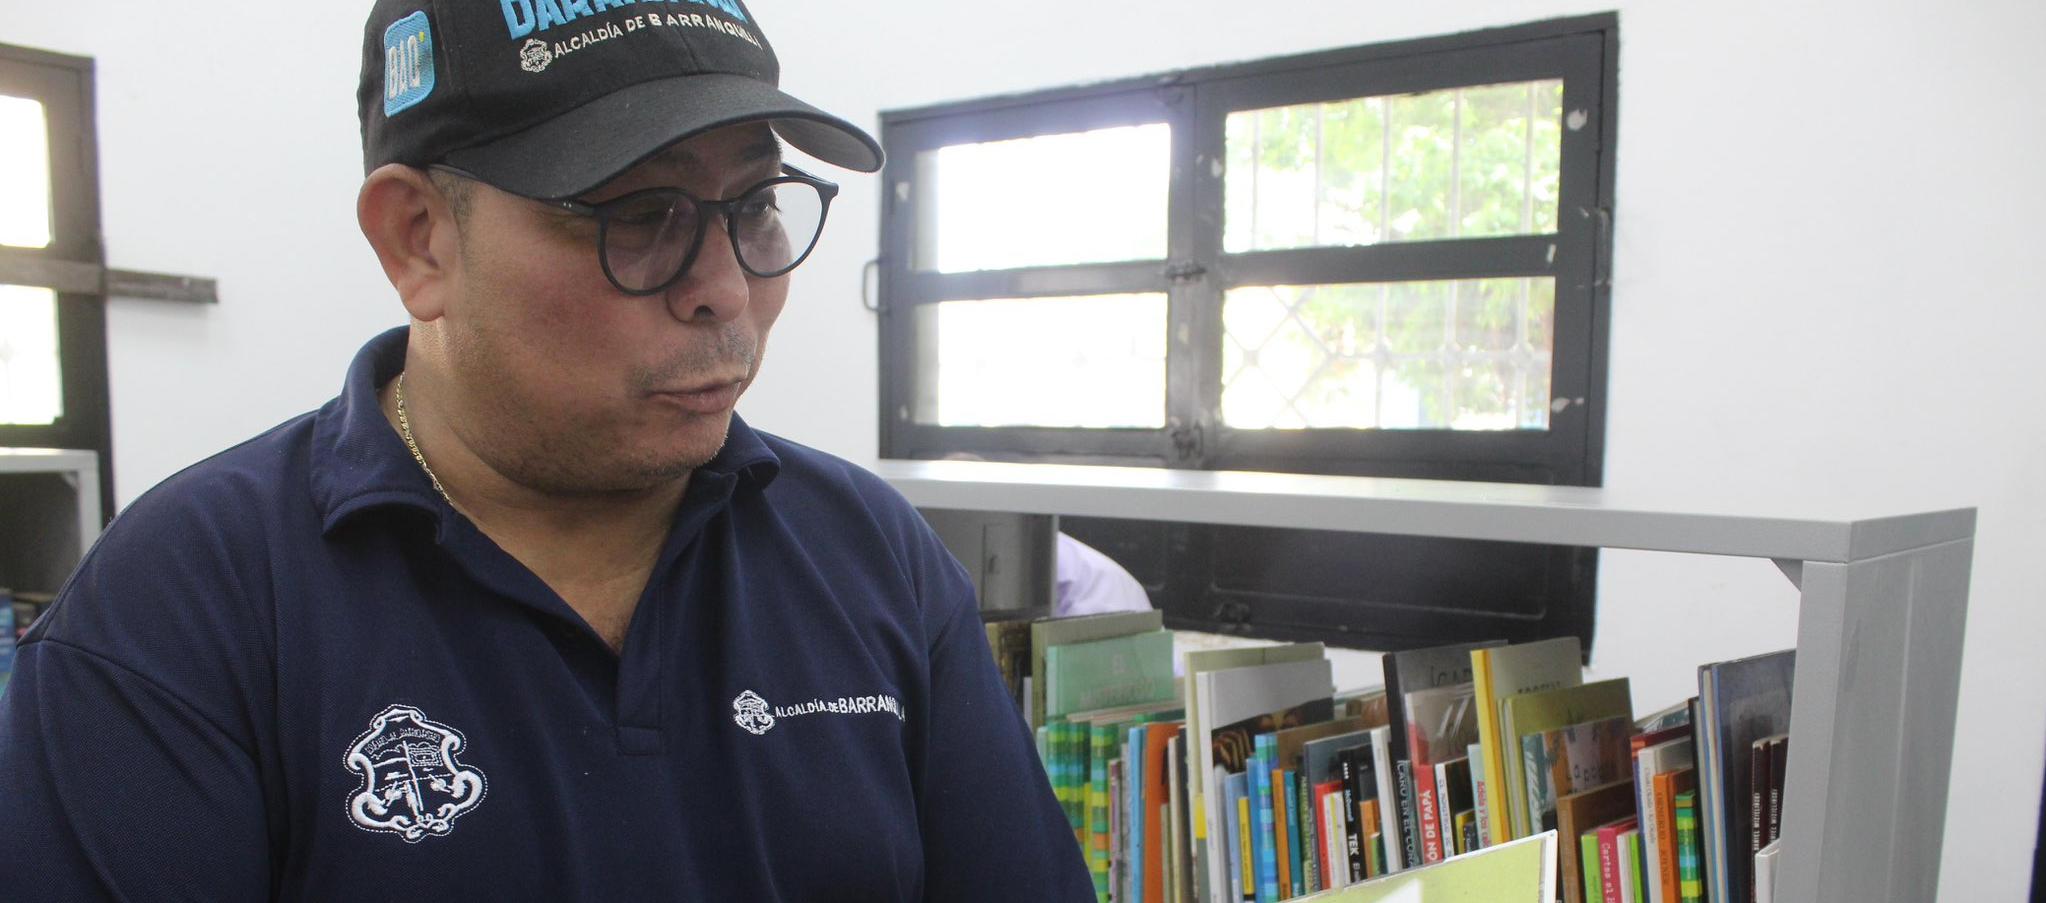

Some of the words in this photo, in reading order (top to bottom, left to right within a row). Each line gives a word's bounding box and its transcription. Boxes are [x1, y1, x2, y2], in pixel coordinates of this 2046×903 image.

[554, 21, 624, 58] ALCALDÍA
[625, 16, 645, 33] DE
[774, 698, 826, 718] ALCALDÍA
[827, 703, 838, 713] DE
[1400, 800, 1410, 817] EN
[1419, 789, 1434, 821] PAPÁ
[1402, 819, 1412, 833] EL
[1424, 823, 1436, 839] DE
[1348, 833, 1359, 856] TEK
